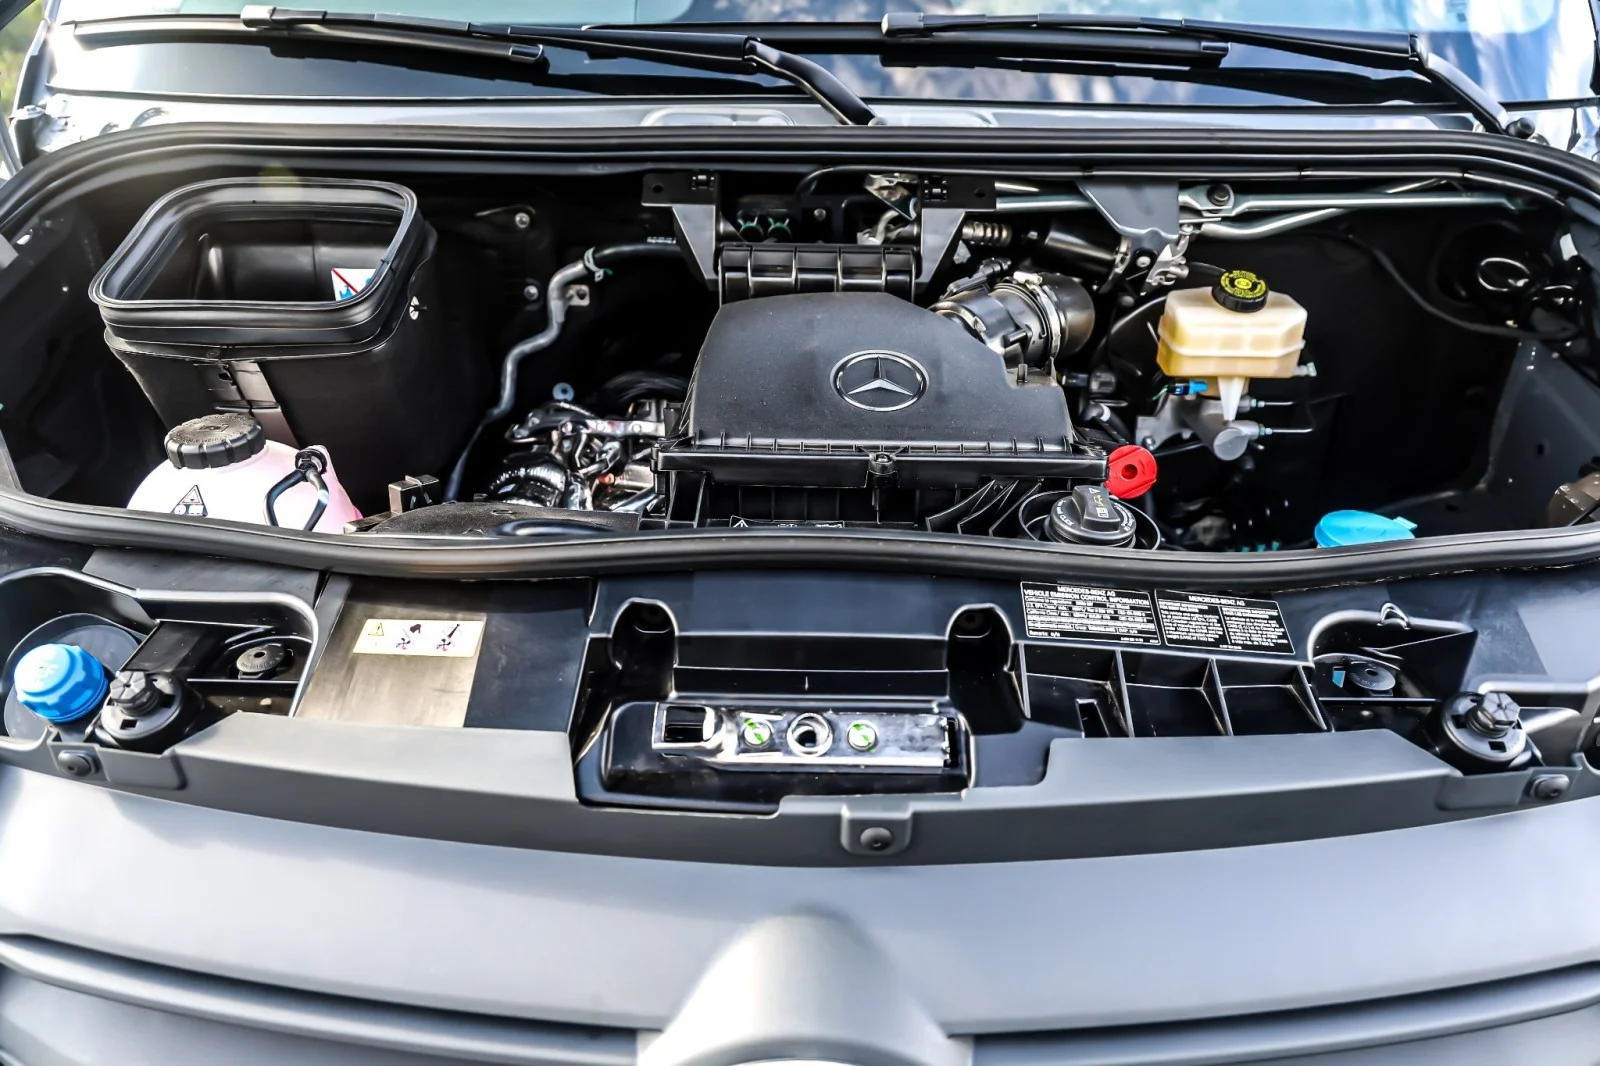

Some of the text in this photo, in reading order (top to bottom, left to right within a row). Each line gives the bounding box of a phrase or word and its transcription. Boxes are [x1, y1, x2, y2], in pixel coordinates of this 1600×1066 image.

[1057, 586, 1106, 596] MERCEDES-BENZ
[1024, 589, 1150, 606] VEHICLE EMISSION CONTROL INFORMATION
[1188, 595, 1236, 605] MERCEDES-BENZ
